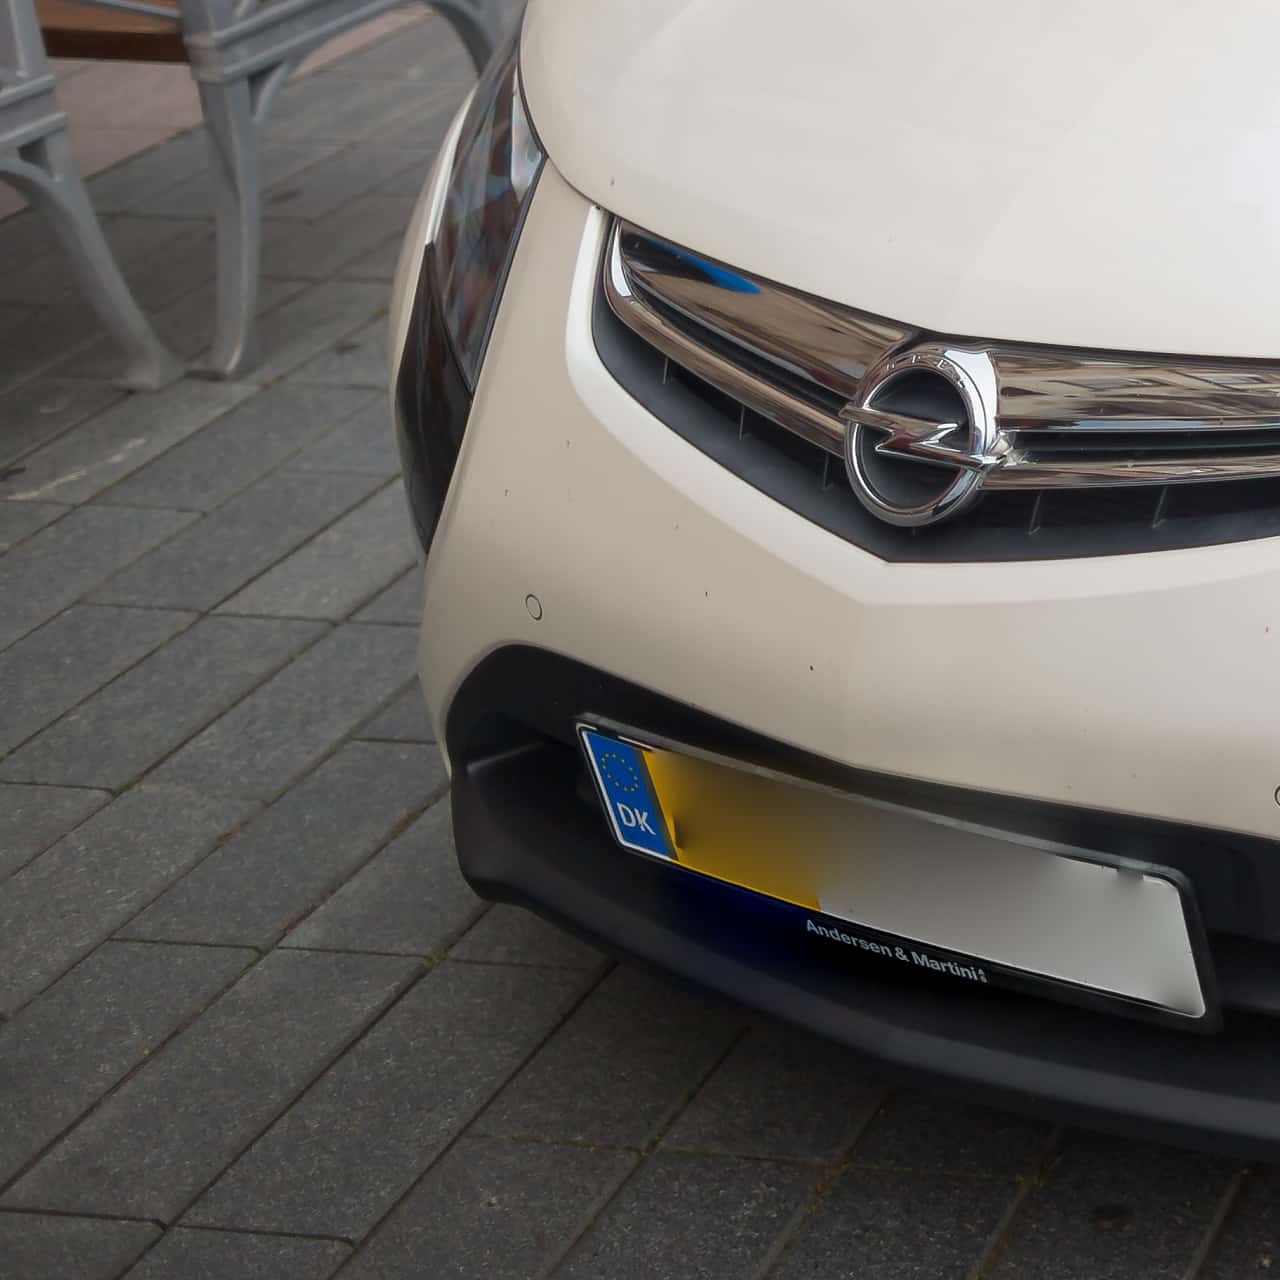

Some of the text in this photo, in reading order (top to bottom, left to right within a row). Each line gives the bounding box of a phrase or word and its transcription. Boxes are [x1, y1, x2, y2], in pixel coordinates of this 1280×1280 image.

[616, 801, 656, 836] DK
[806, 919, 892, 958] Andersen
[894, 946, 910, 963] &
[911, 951, 978, 981] Martini
